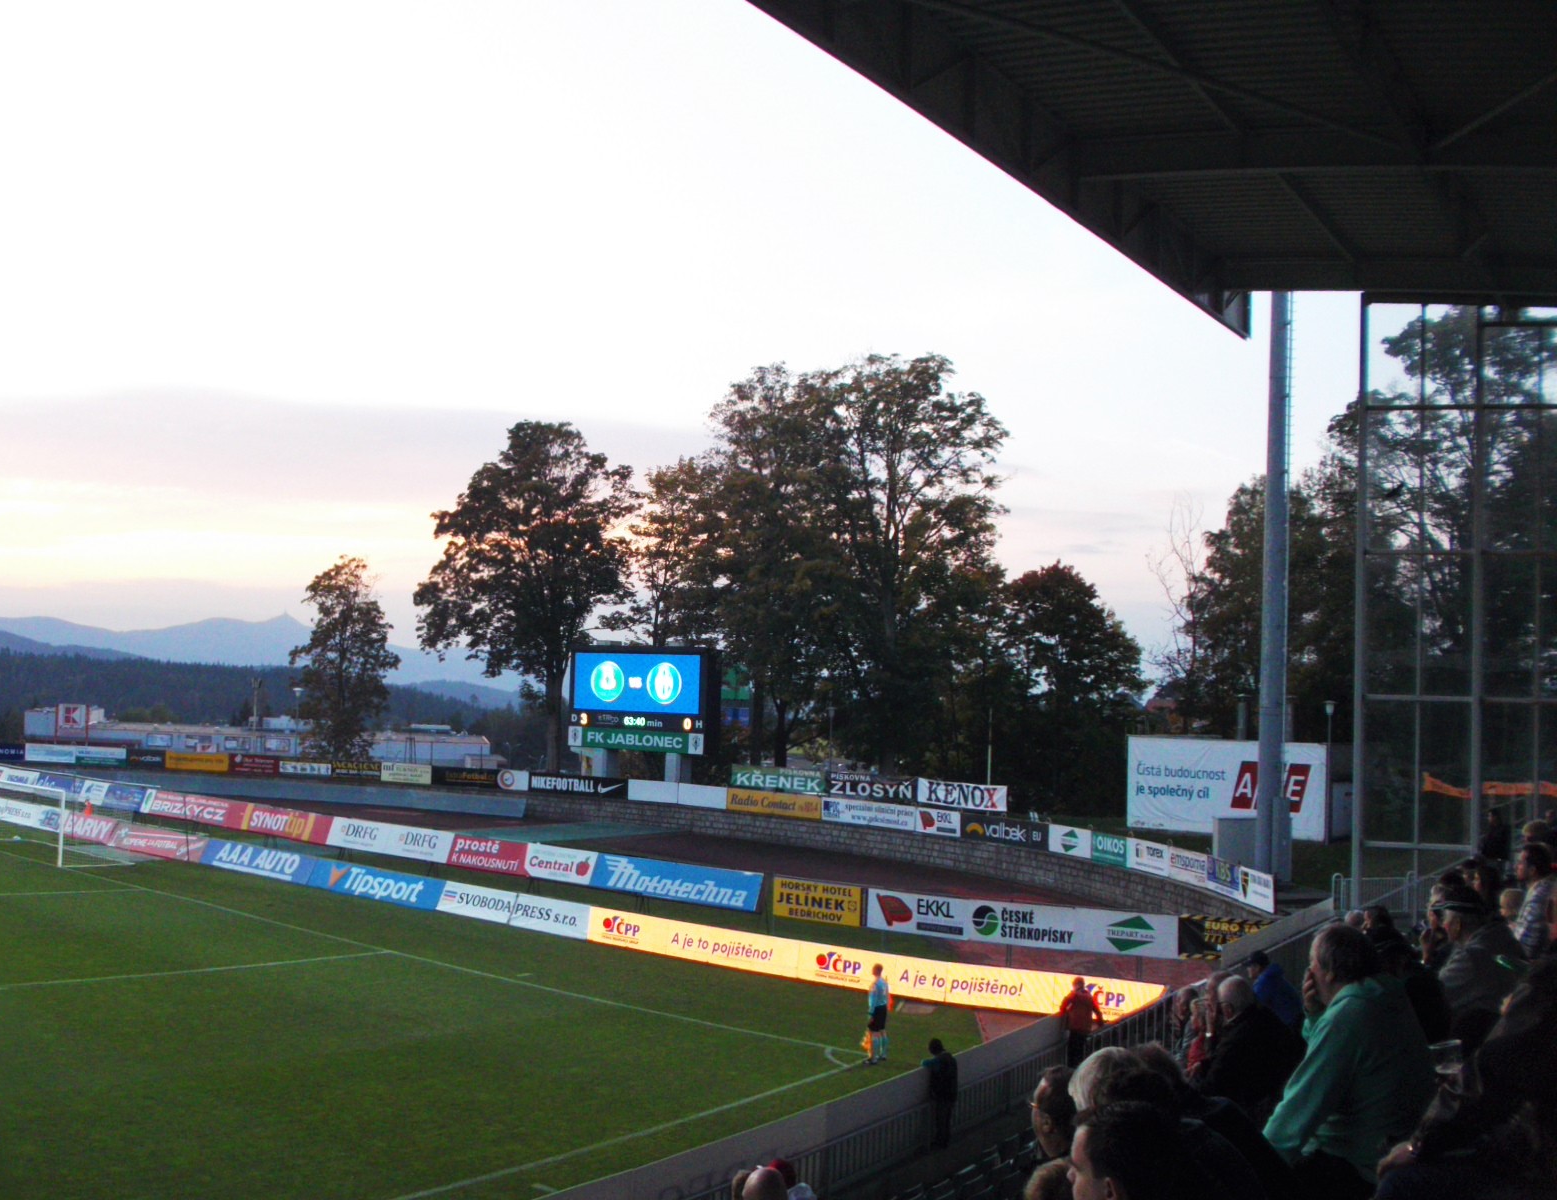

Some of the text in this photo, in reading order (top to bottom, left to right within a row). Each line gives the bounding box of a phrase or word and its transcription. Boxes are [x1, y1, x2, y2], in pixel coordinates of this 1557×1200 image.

[571, 714, 577, 722] D
[580, 714, 588, 725] 3
[647, 720, 663, 728] min
[683, 718, 703, 730] 0 H
[587, 732, 683, 748] FK JABLONEC
[1137, 762, 1227, 780] Čistá budoucnost
[531, 776, 595, 792] NIKEFOOTBALL
[737, 770, 821, 791] KŘENEK
[830, 781, 912, 800] ZLOSYŇ
[927, 781, 997, 810] KENOX
[1135, 782, 1209, 800] je společný cíl
[731, 794, 758, 808] Radio
[761, 797, 796, 812] Contact
[66, 814, 113, 840] BARVY
[345, 824, 379, 841] DRFG
[984, 822, 1041, 842] valbek EU
[404, 831, 438, 850] DRFG
[455, 837, 501, 854] prostě
[1097, 836, 1125, 854] OIKOS
[215, 842, 301, 874] AAA AUTO
[451, 854, 521, 872] K NAKOUSNUTÍ
[529, 856, 575, 873] Central
[344, 867, 425, 903] Tipsport
[603, 856, 748, 908] Mototechna
[822, 885, 853, 897] HOTEL
[777, 889, 845, 911] JELÍNEK
[917, 898, 954, 918] EKKL
[457, 892, 577, 927] SVOBODA PRESS s.r.o.
[788, 907, 843, 922] BEDŘICHOV
[1001, 907, 1034, 924] ČESKÉ
[617, 918, 640, 936] ČPP
[1000, 925, 1073, 944] ŠTĚRKOPÍSKY
[1107, 928, 1139, 938] TREPART
[1205, 920, 1240, 932] EURO
[671, 932, 773, 960] A je to pojištěno!
[833, 954, 861, 974] ČPP
[899, 969, 1023, 996] A je to pojištěno!
[1093, 986, 1125, 1008] ČPP
